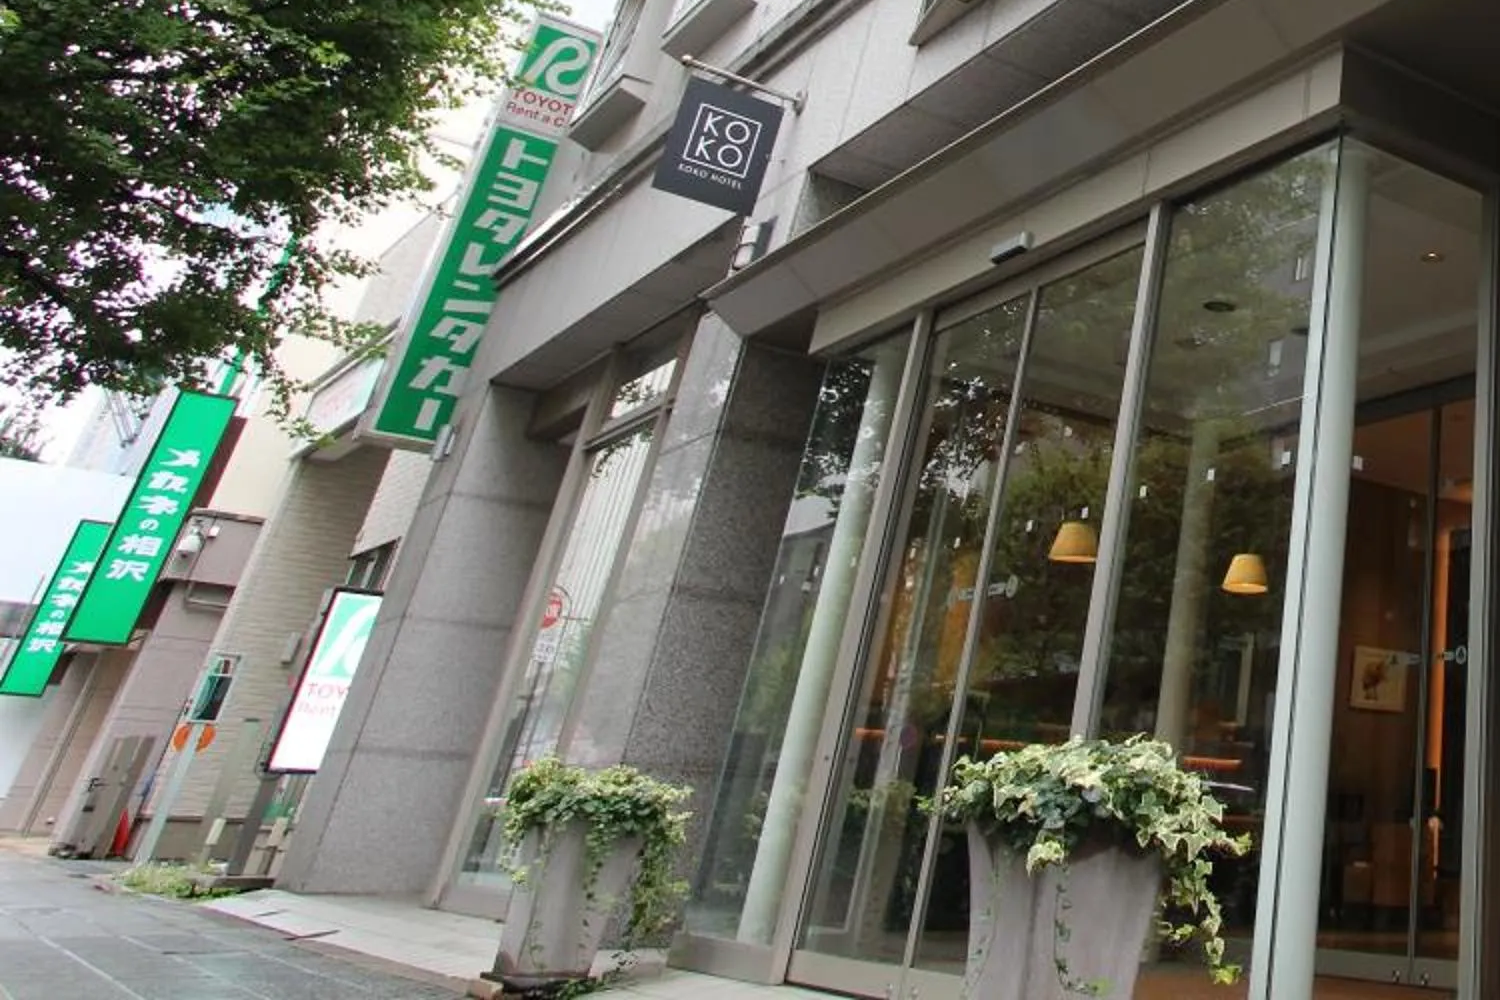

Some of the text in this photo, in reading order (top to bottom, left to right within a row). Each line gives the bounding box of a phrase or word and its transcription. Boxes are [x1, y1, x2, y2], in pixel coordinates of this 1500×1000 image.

[513, 89, 576, 115] TOYOT
[678, 163, 742, 190] KOKO HOTEL
[409, 138, 548, 431] トヨタレンタカー
[105, 447, 200, 581] メガネの相沢
